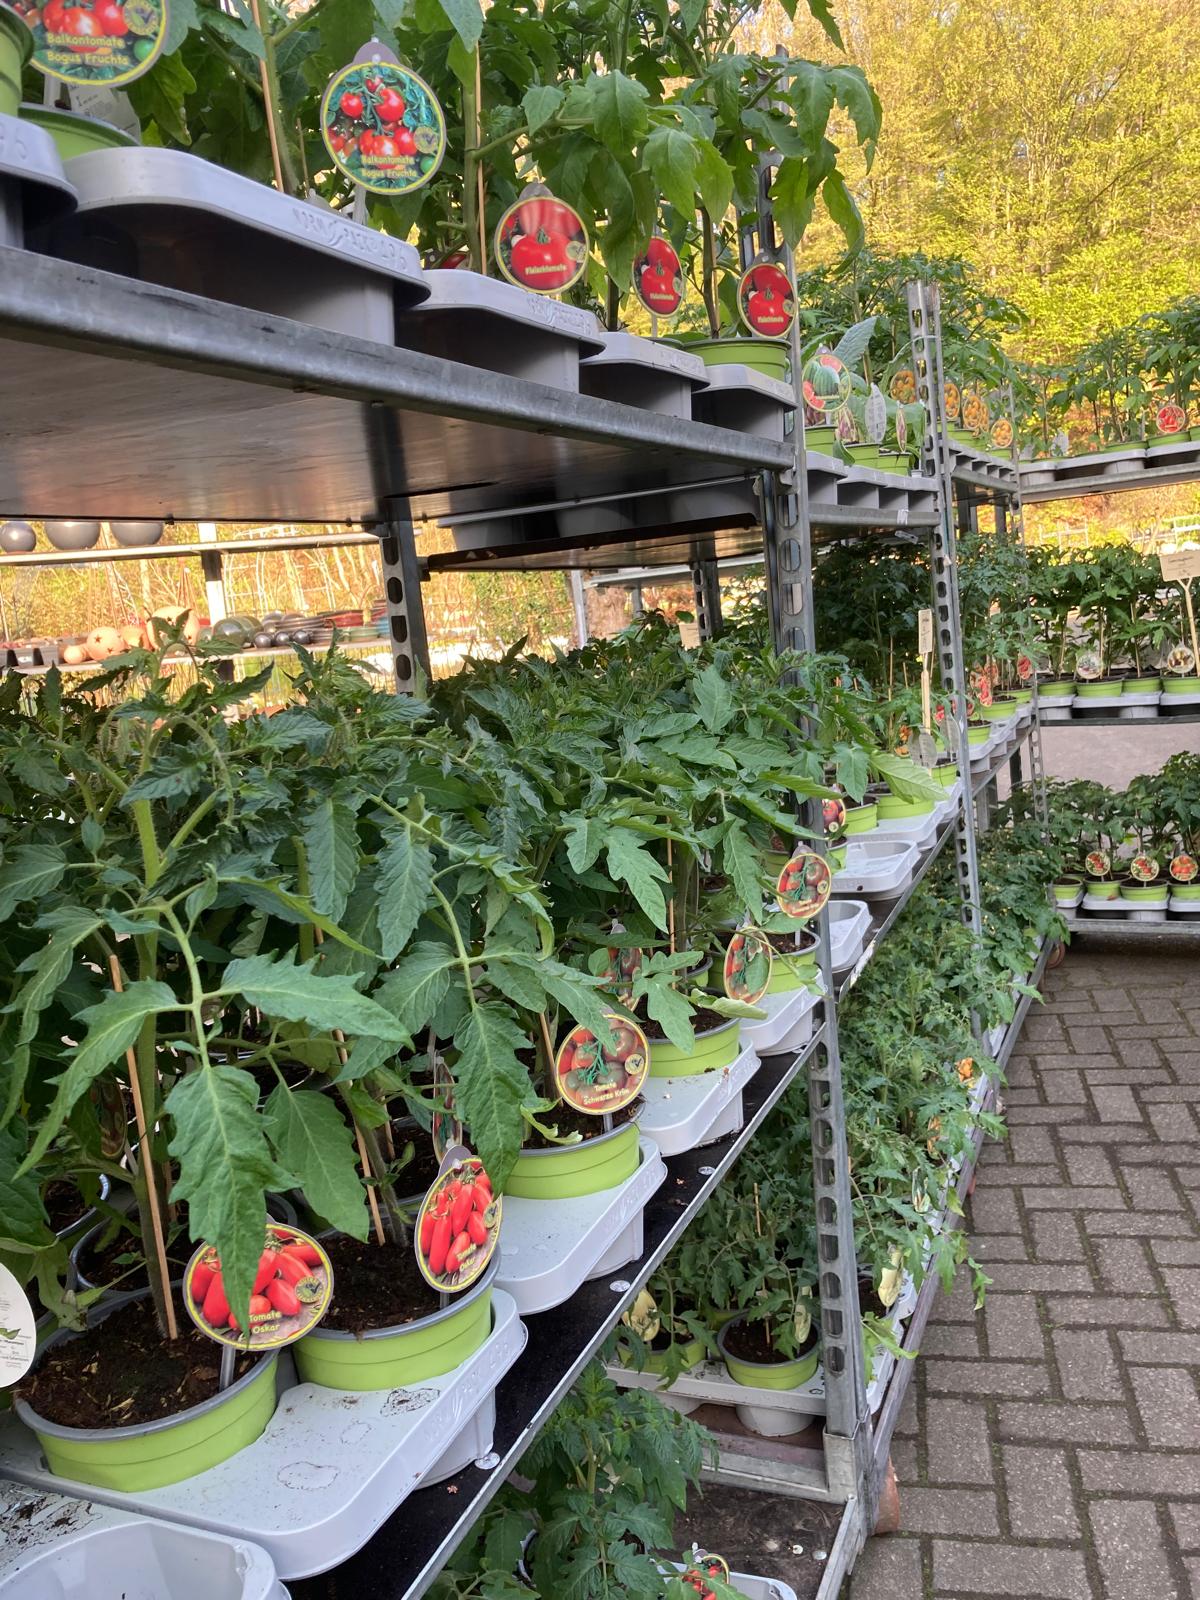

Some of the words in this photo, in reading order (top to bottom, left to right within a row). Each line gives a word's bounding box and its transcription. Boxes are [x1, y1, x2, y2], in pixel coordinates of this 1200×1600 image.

[47, 32, 125, 49] Balkontomate
[47, 51, 81, 65] Bogus
[249, 1310, 282, 1322] Tomate
[252, 1324, 281, 1334] Oskar
